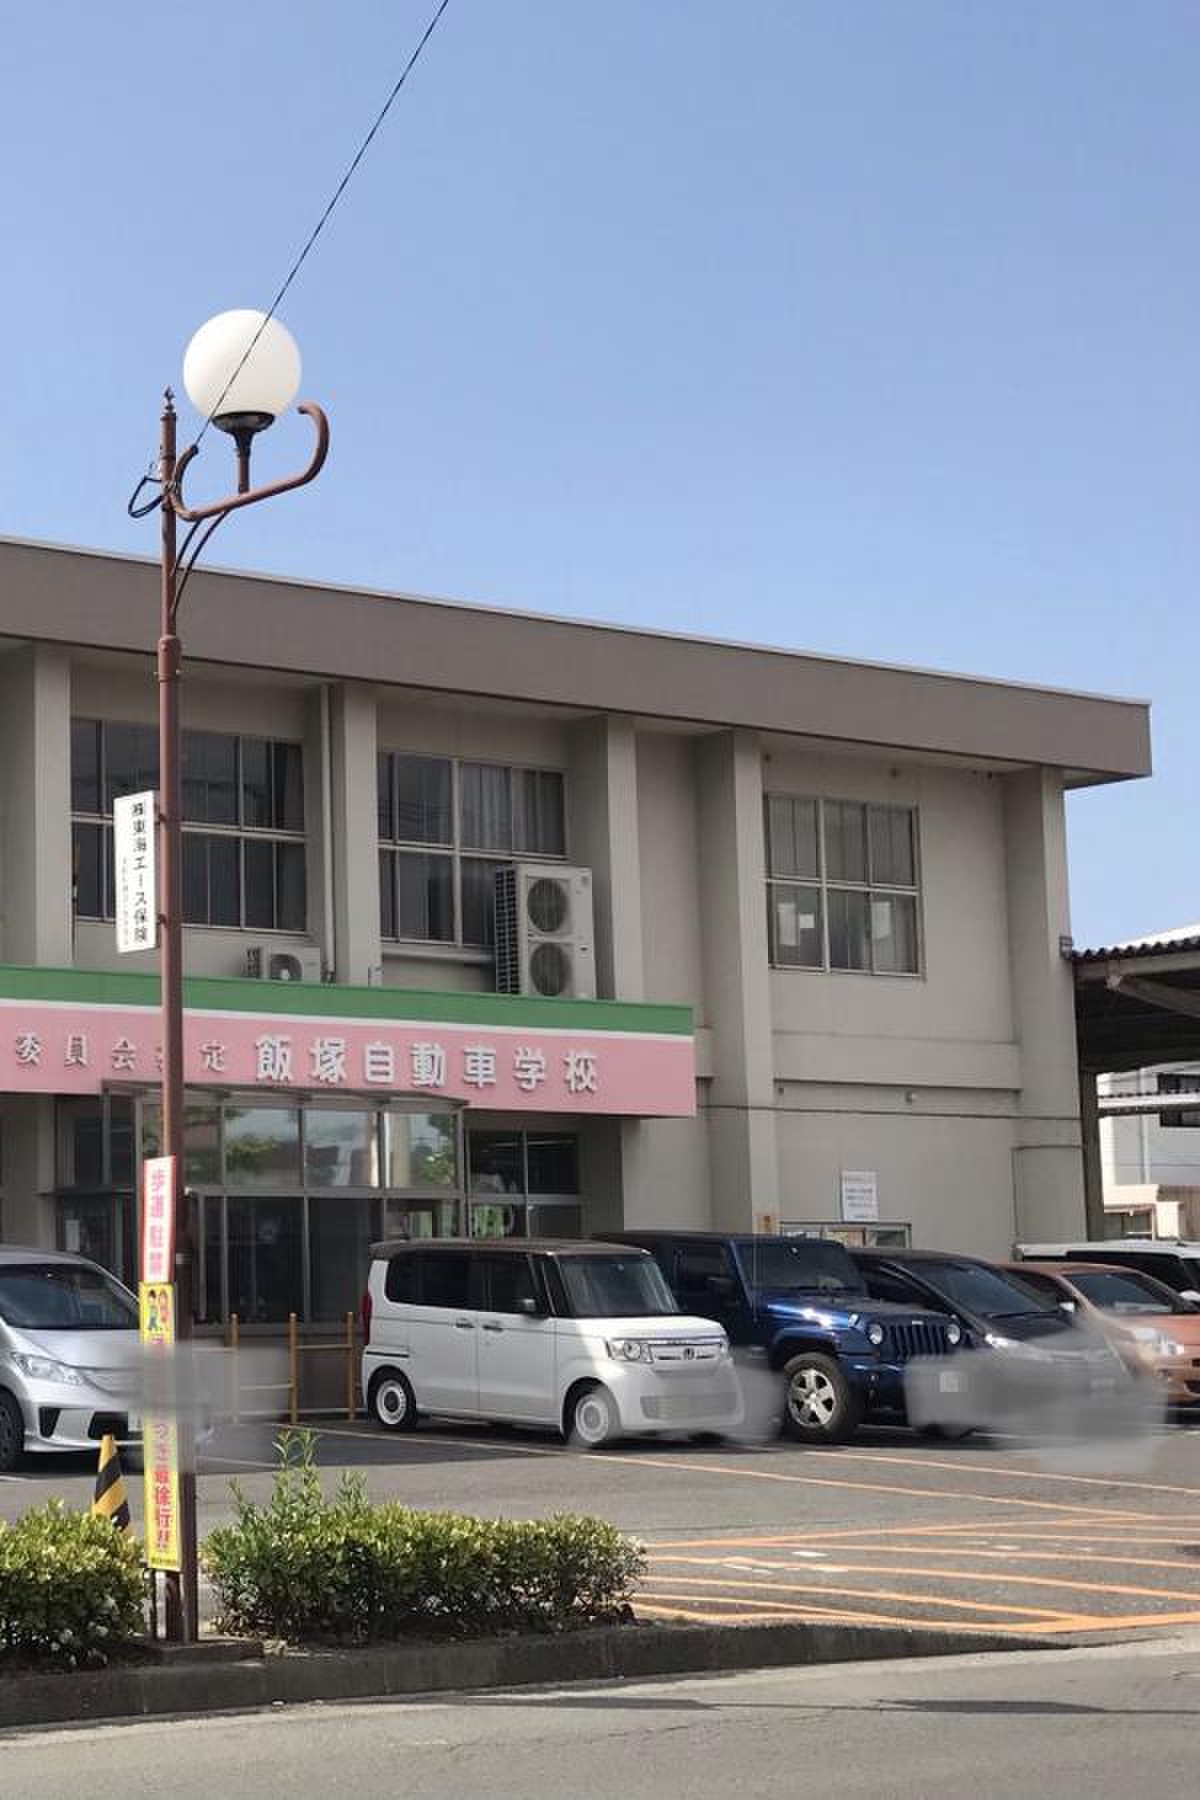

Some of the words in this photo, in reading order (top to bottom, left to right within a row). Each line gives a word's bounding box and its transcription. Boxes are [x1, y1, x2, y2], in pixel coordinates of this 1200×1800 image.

[254, 1032, 599, 1094] 飯塚自動車学校
